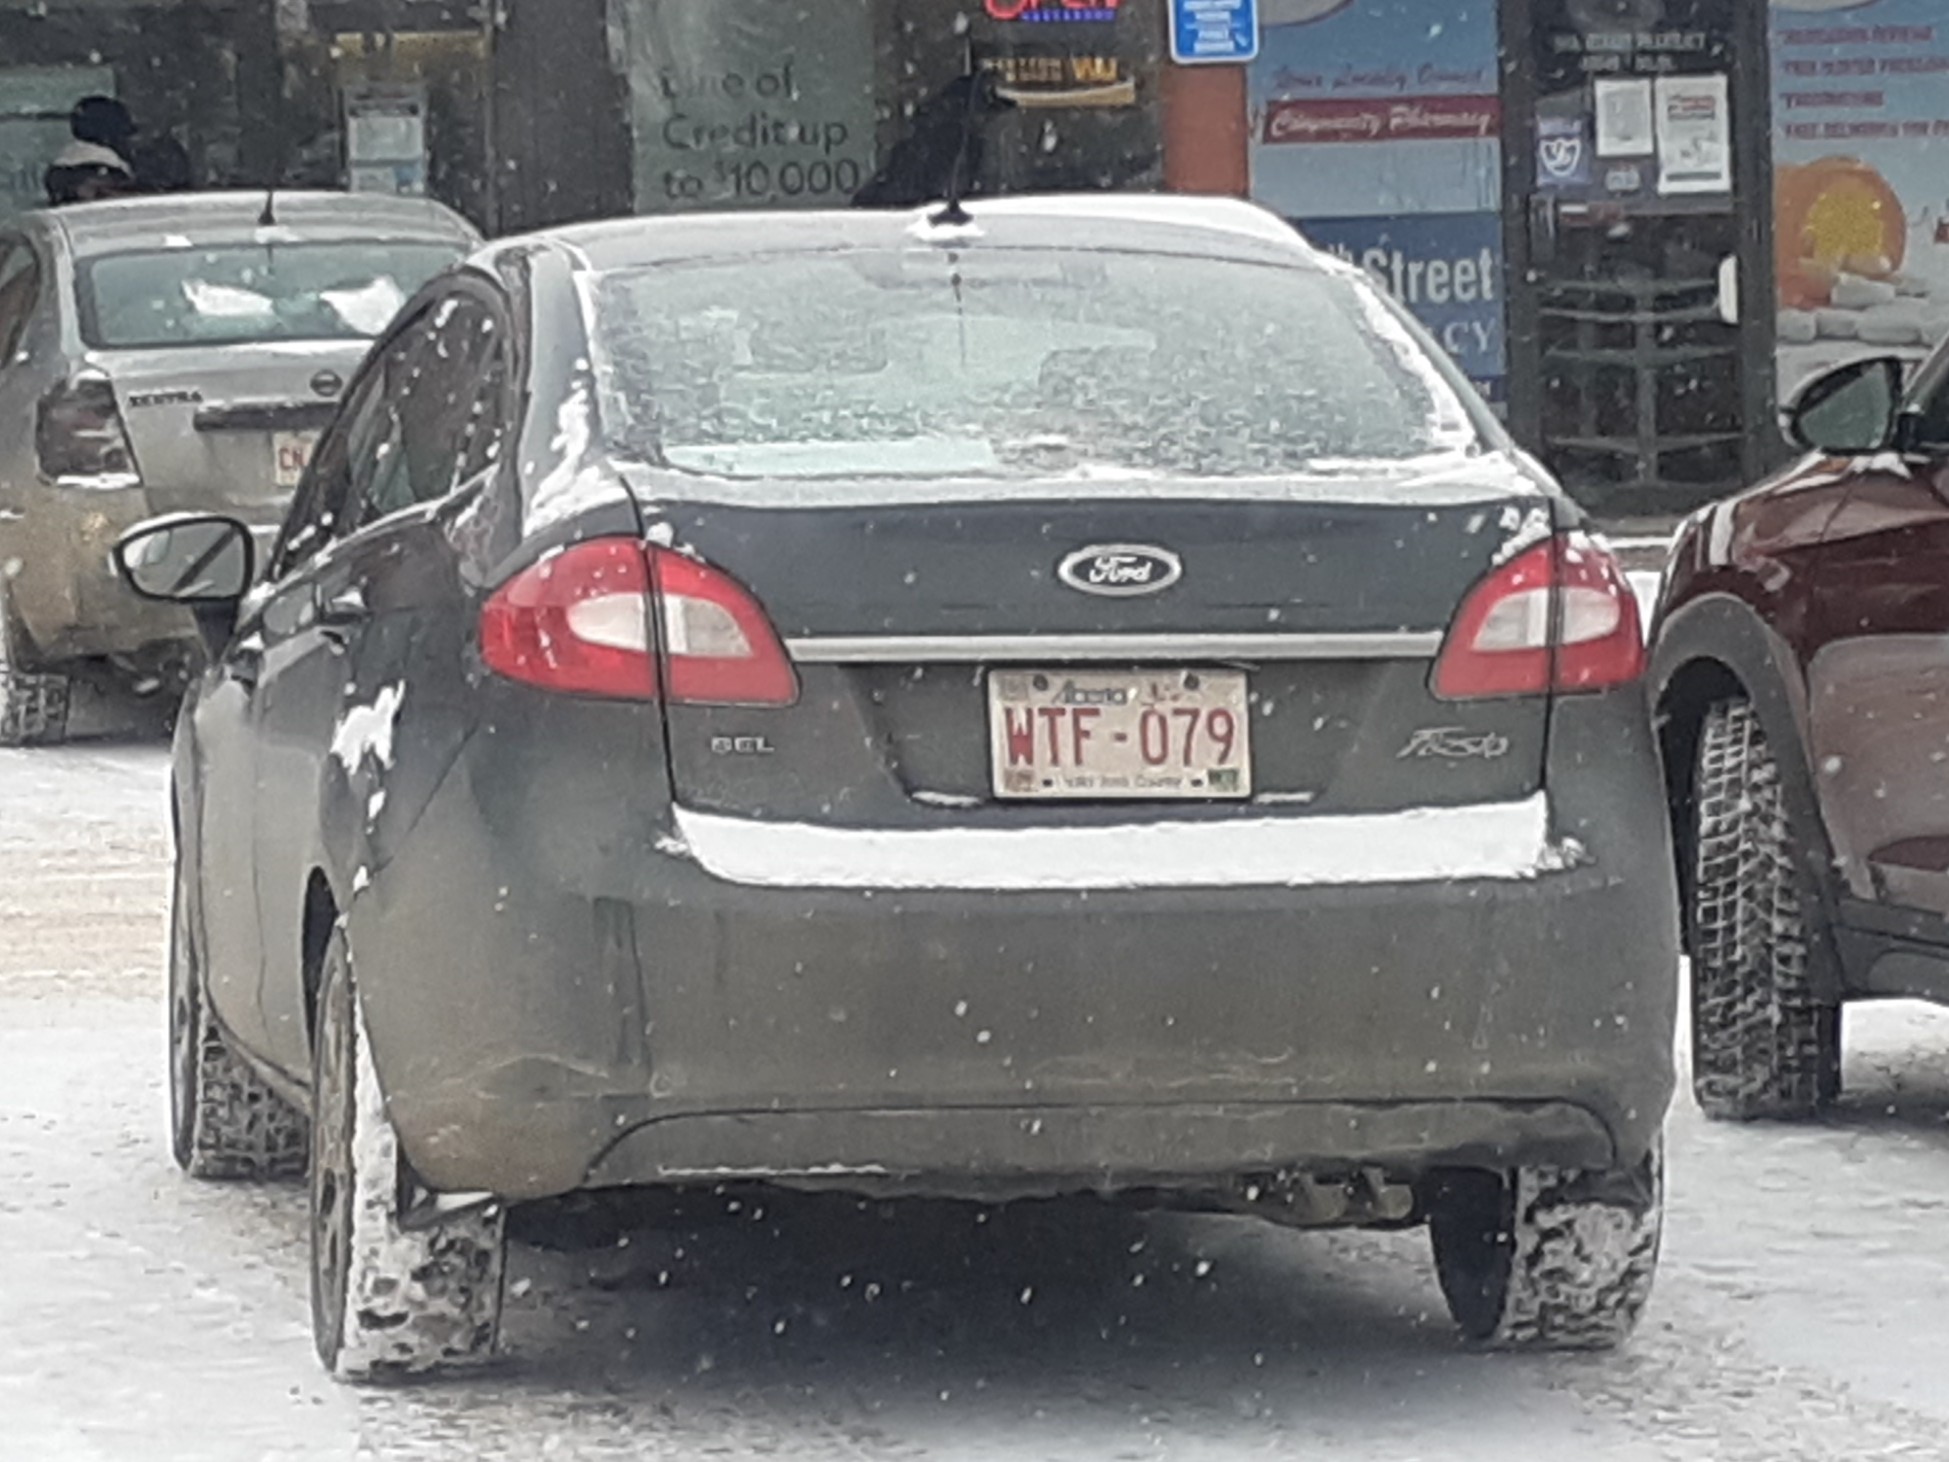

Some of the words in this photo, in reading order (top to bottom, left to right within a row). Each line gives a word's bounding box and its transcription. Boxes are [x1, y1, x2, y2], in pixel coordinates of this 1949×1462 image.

[663, 112, 790, 150] Credit
[799, 120, 848, 155] up
[1362, 246, 1494, 304] Street
[1089, 556, 1153, 583] Ford
[1004, 706, 1236, 767] WTF-079
